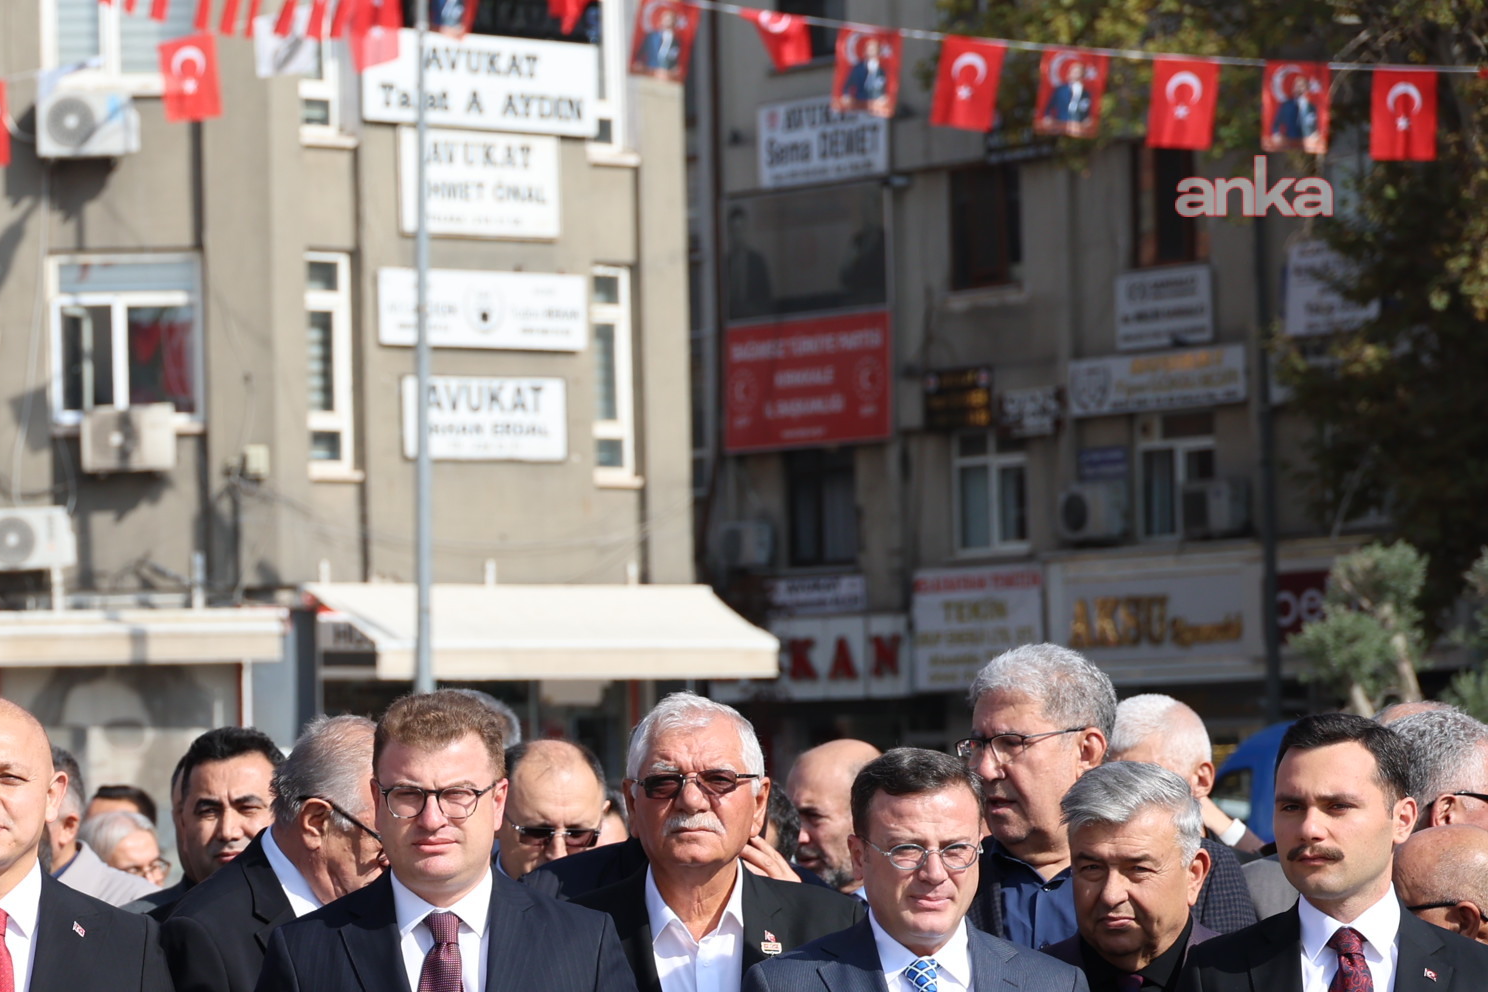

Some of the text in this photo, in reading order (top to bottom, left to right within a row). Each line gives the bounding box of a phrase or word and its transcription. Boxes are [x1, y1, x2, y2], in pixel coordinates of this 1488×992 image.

[425, 46, 538, 77] AVUKAT
[379, 83, 583, 120] Taat A AYDIN
[425, 141, 532, 168] AVUKAT
[425, 180, 484, 201] HMET
[426, 383, 543, 412] AVUKAT
